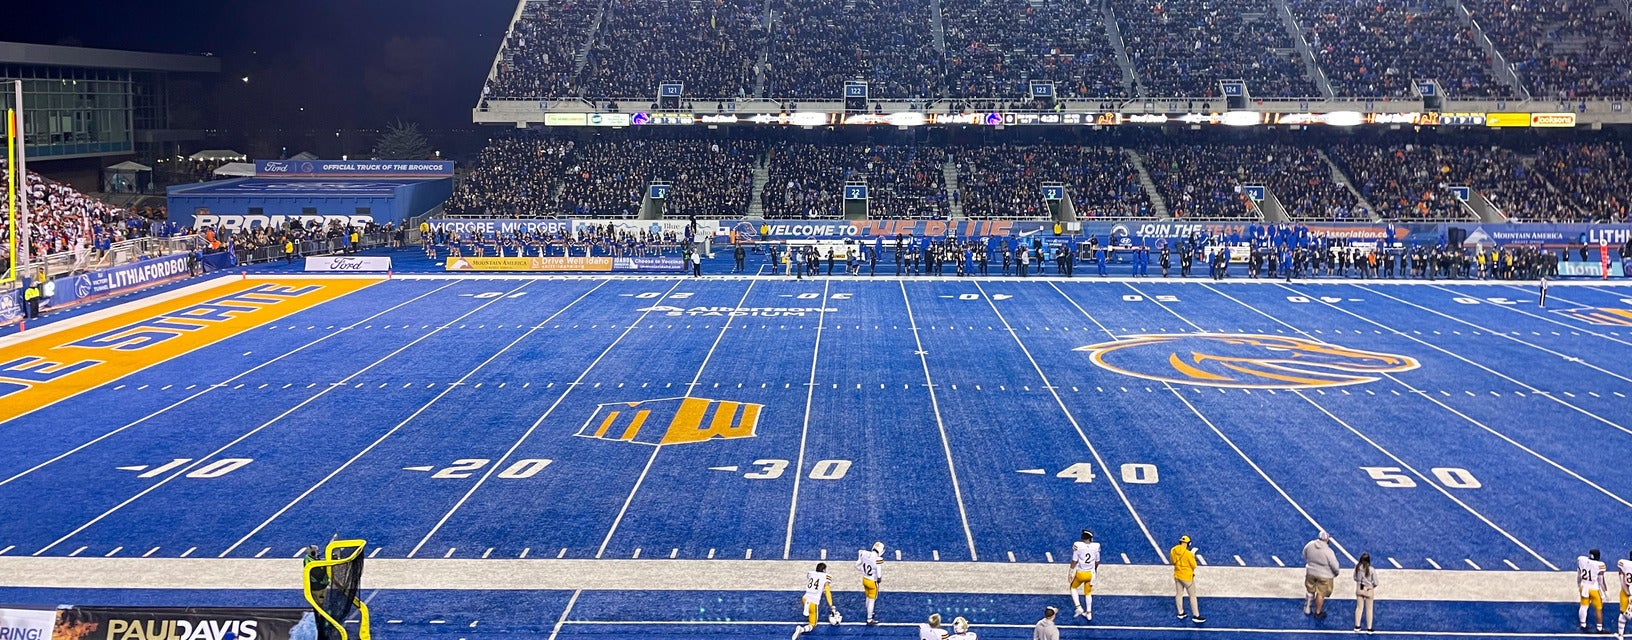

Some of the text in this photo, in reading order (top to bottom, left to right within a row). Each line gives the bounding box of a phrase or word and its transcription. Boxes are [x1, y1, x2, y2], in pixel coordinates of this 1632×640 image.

[1226, 86, 1237, 94] 124
[264, 161, 289, 173] Ford
[767, 225, 835, 237] WELCOME
[839, 225, 859, 237] TO
[1136, 223, 1171, 237] JOIN
[1532, 231, 1563, 239] AMERICA
[330, 257, 363, 270] Ford
[541, 256, 609, 266] Drive Well Idaho
[49, 283, 328, 352] STATE
[1084, 552, 1091, 565] 2
[862, 562, 873, 577] 12
[1581, 568, 1593, 582] 21
[807, 577, 820, 591] 34
